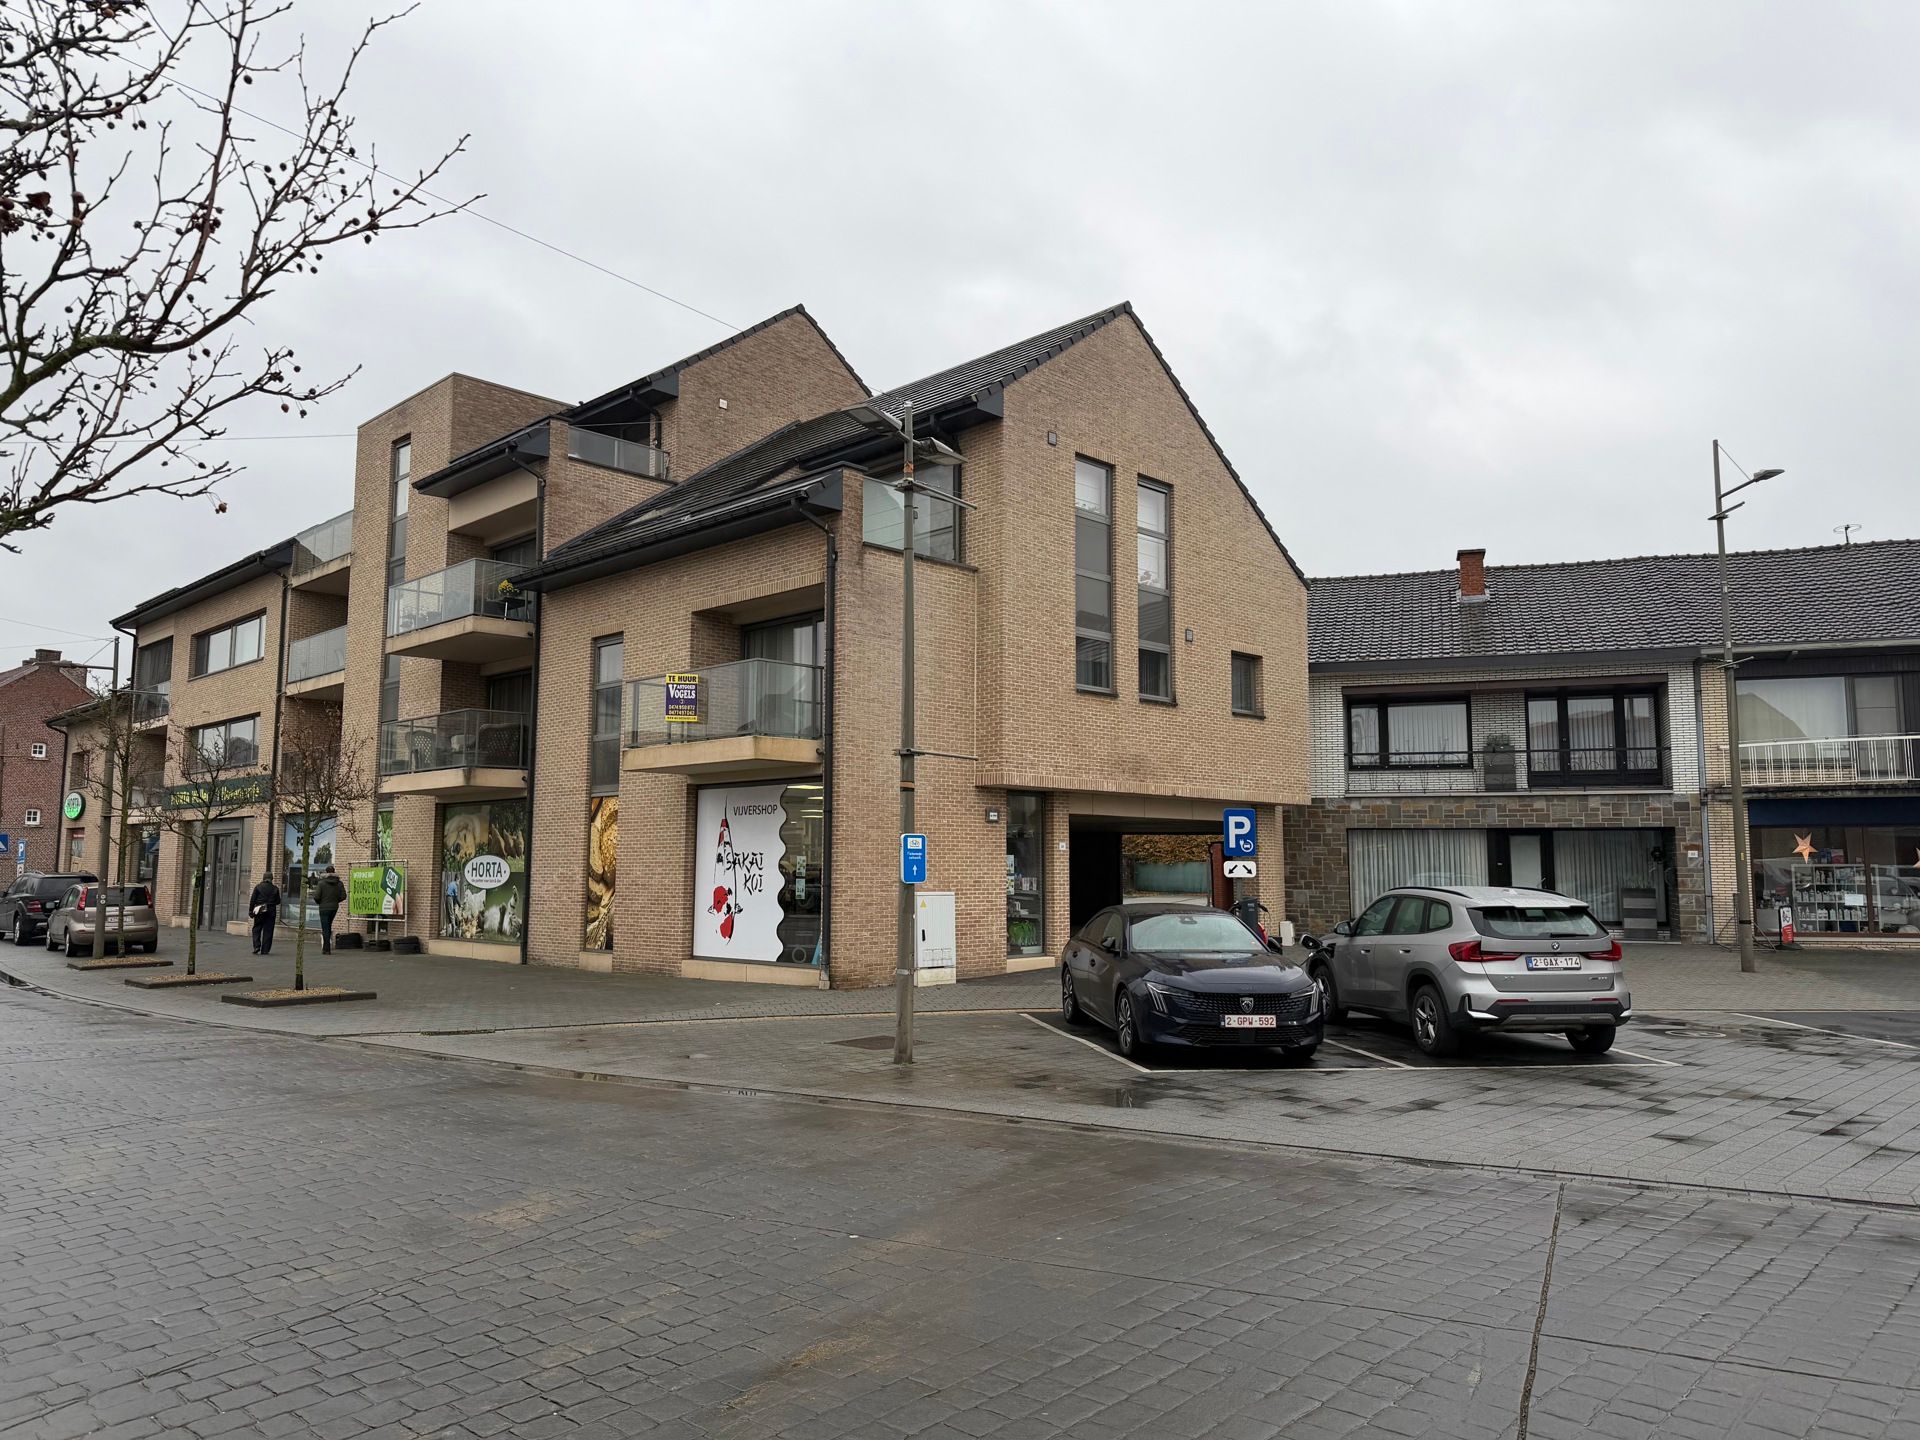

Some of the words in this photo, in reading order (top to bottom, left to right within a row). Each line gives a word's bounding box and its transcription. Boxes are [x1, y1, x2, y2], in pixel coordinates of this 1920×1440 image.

[733, 804, 778, 816] VIJVERSHOP
[1228, 815, 1251, 848] P
[471, 861, 503, 878] HORTA
[726, 851, 764, 873] SAKAI
[743, 873, 764, 896] KOI
[353, 896, 380, 912] VOORDELEN
